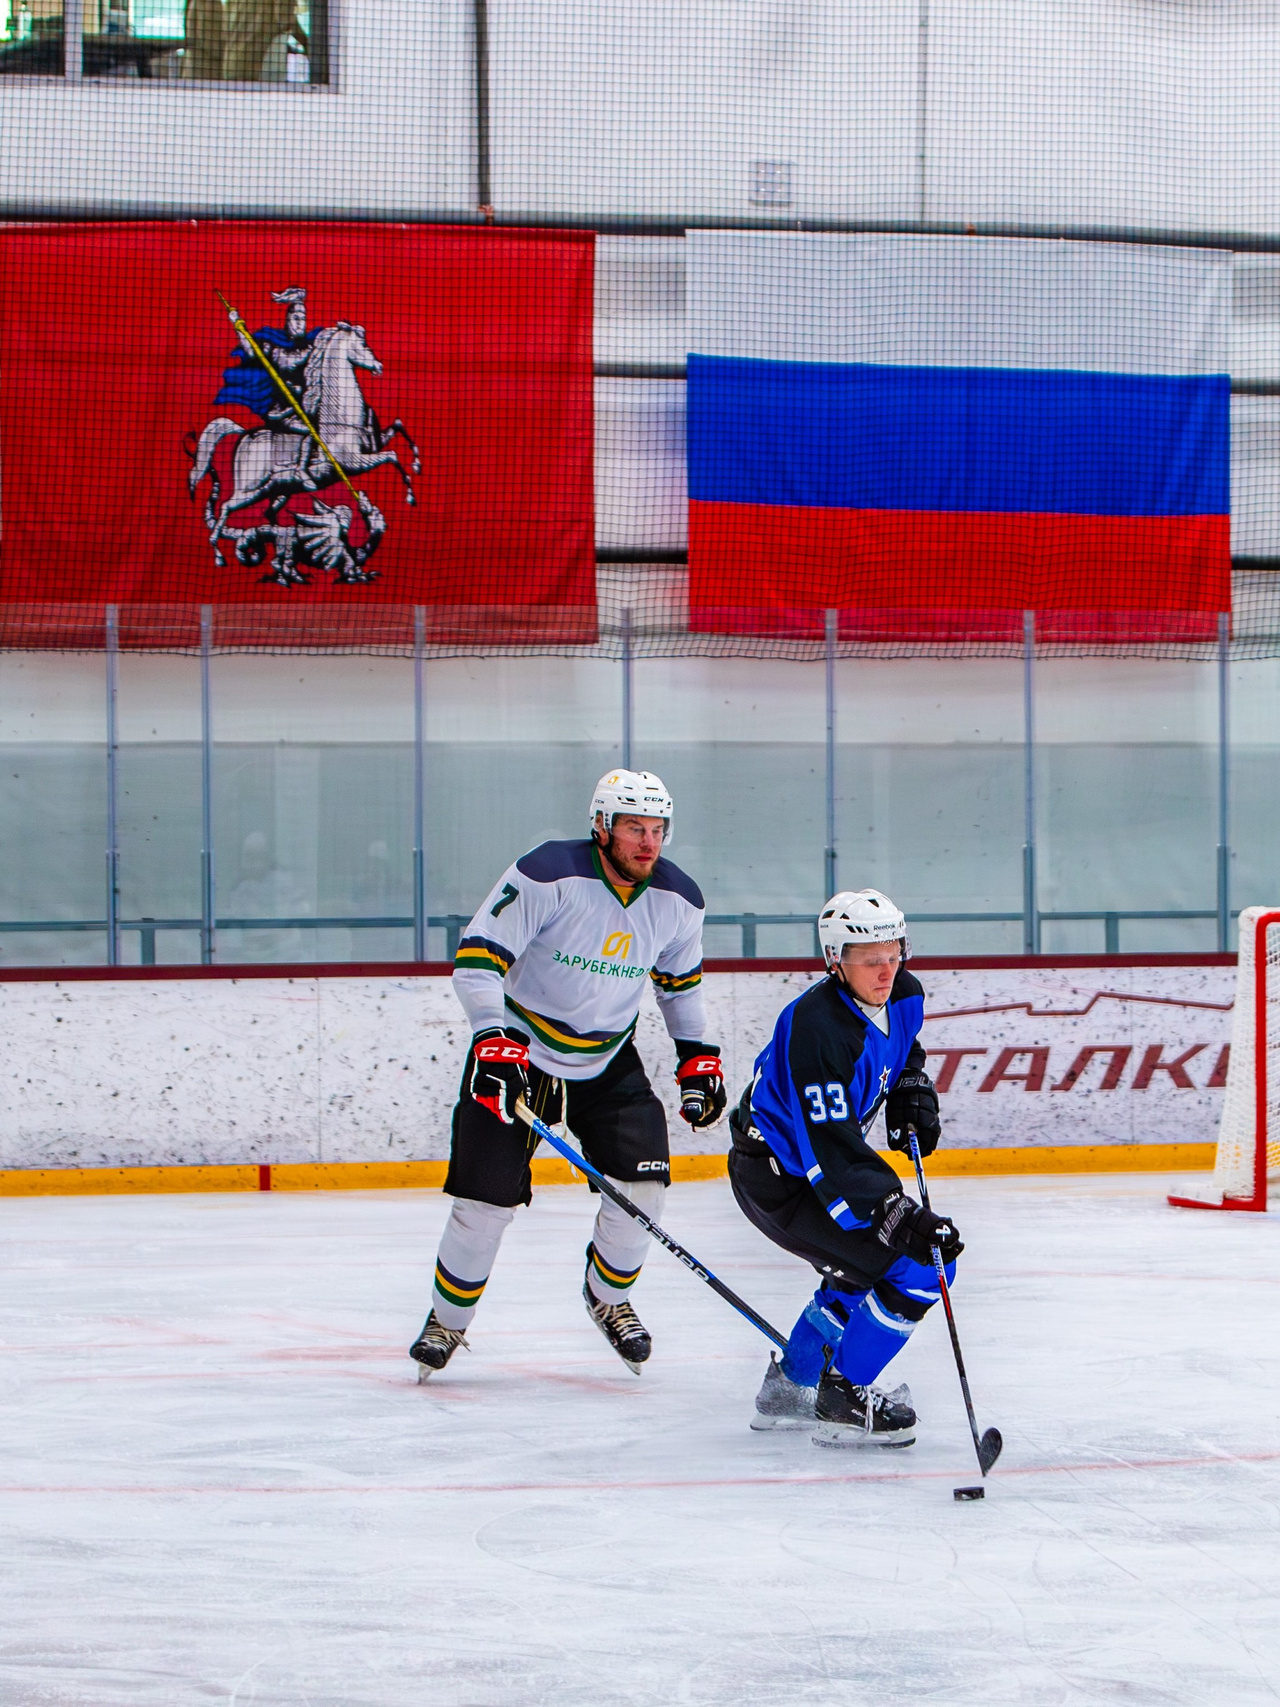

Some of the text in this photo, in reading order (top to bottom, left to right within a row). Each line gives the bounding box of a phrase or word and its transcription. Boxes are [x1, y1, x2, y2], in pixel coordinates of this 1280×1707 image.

[490, 882, 519, 918] 7
[873, 922, 896, 931] Reebok
[803, 1082, 849, 1124] 33
[637, 1160, 670, 1172] CCM
